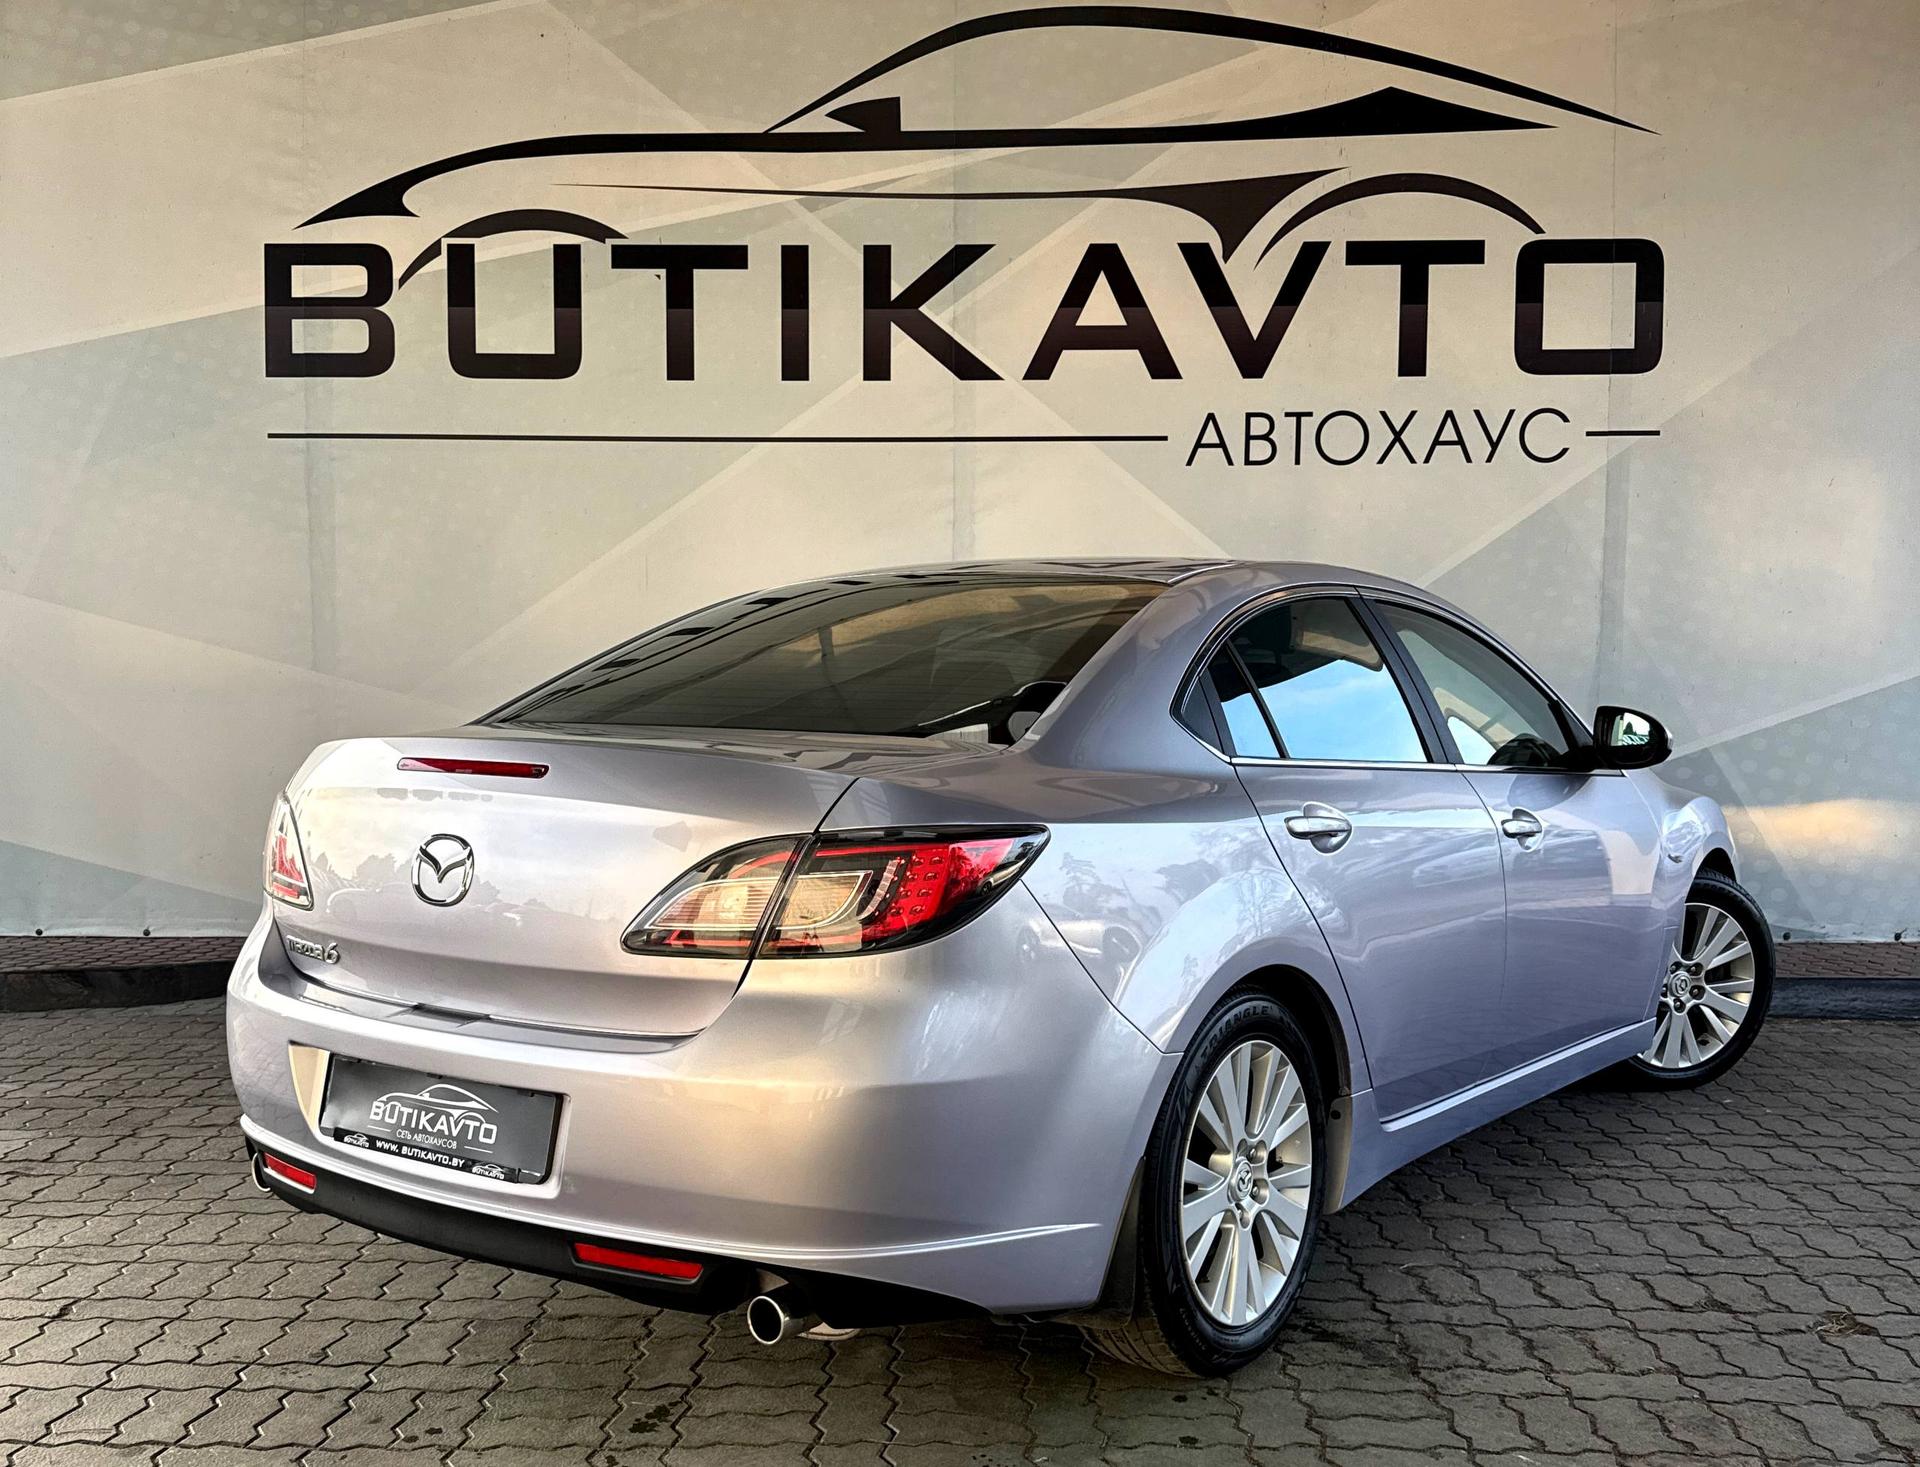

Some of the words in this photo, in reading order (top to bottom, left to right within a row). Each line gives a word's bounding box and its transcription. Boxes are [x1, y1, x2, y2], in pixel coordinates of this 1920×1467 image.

[264, 239, 1665, 382] BUTIKAVTO
[1186, 408, 1571, 467] АВТОХАУС
[1200, 1005, 1270, 1062] TRIANGLE
[369, 1100, 498, 1145] BUTIKAVTO
[396, 1129, 412, 1140] СЕТЬ
[413, 1133, 457, 1150] АВТОХАУСОВ
[401, 1146, 465, 1167] BUTIKAVTO.BY
